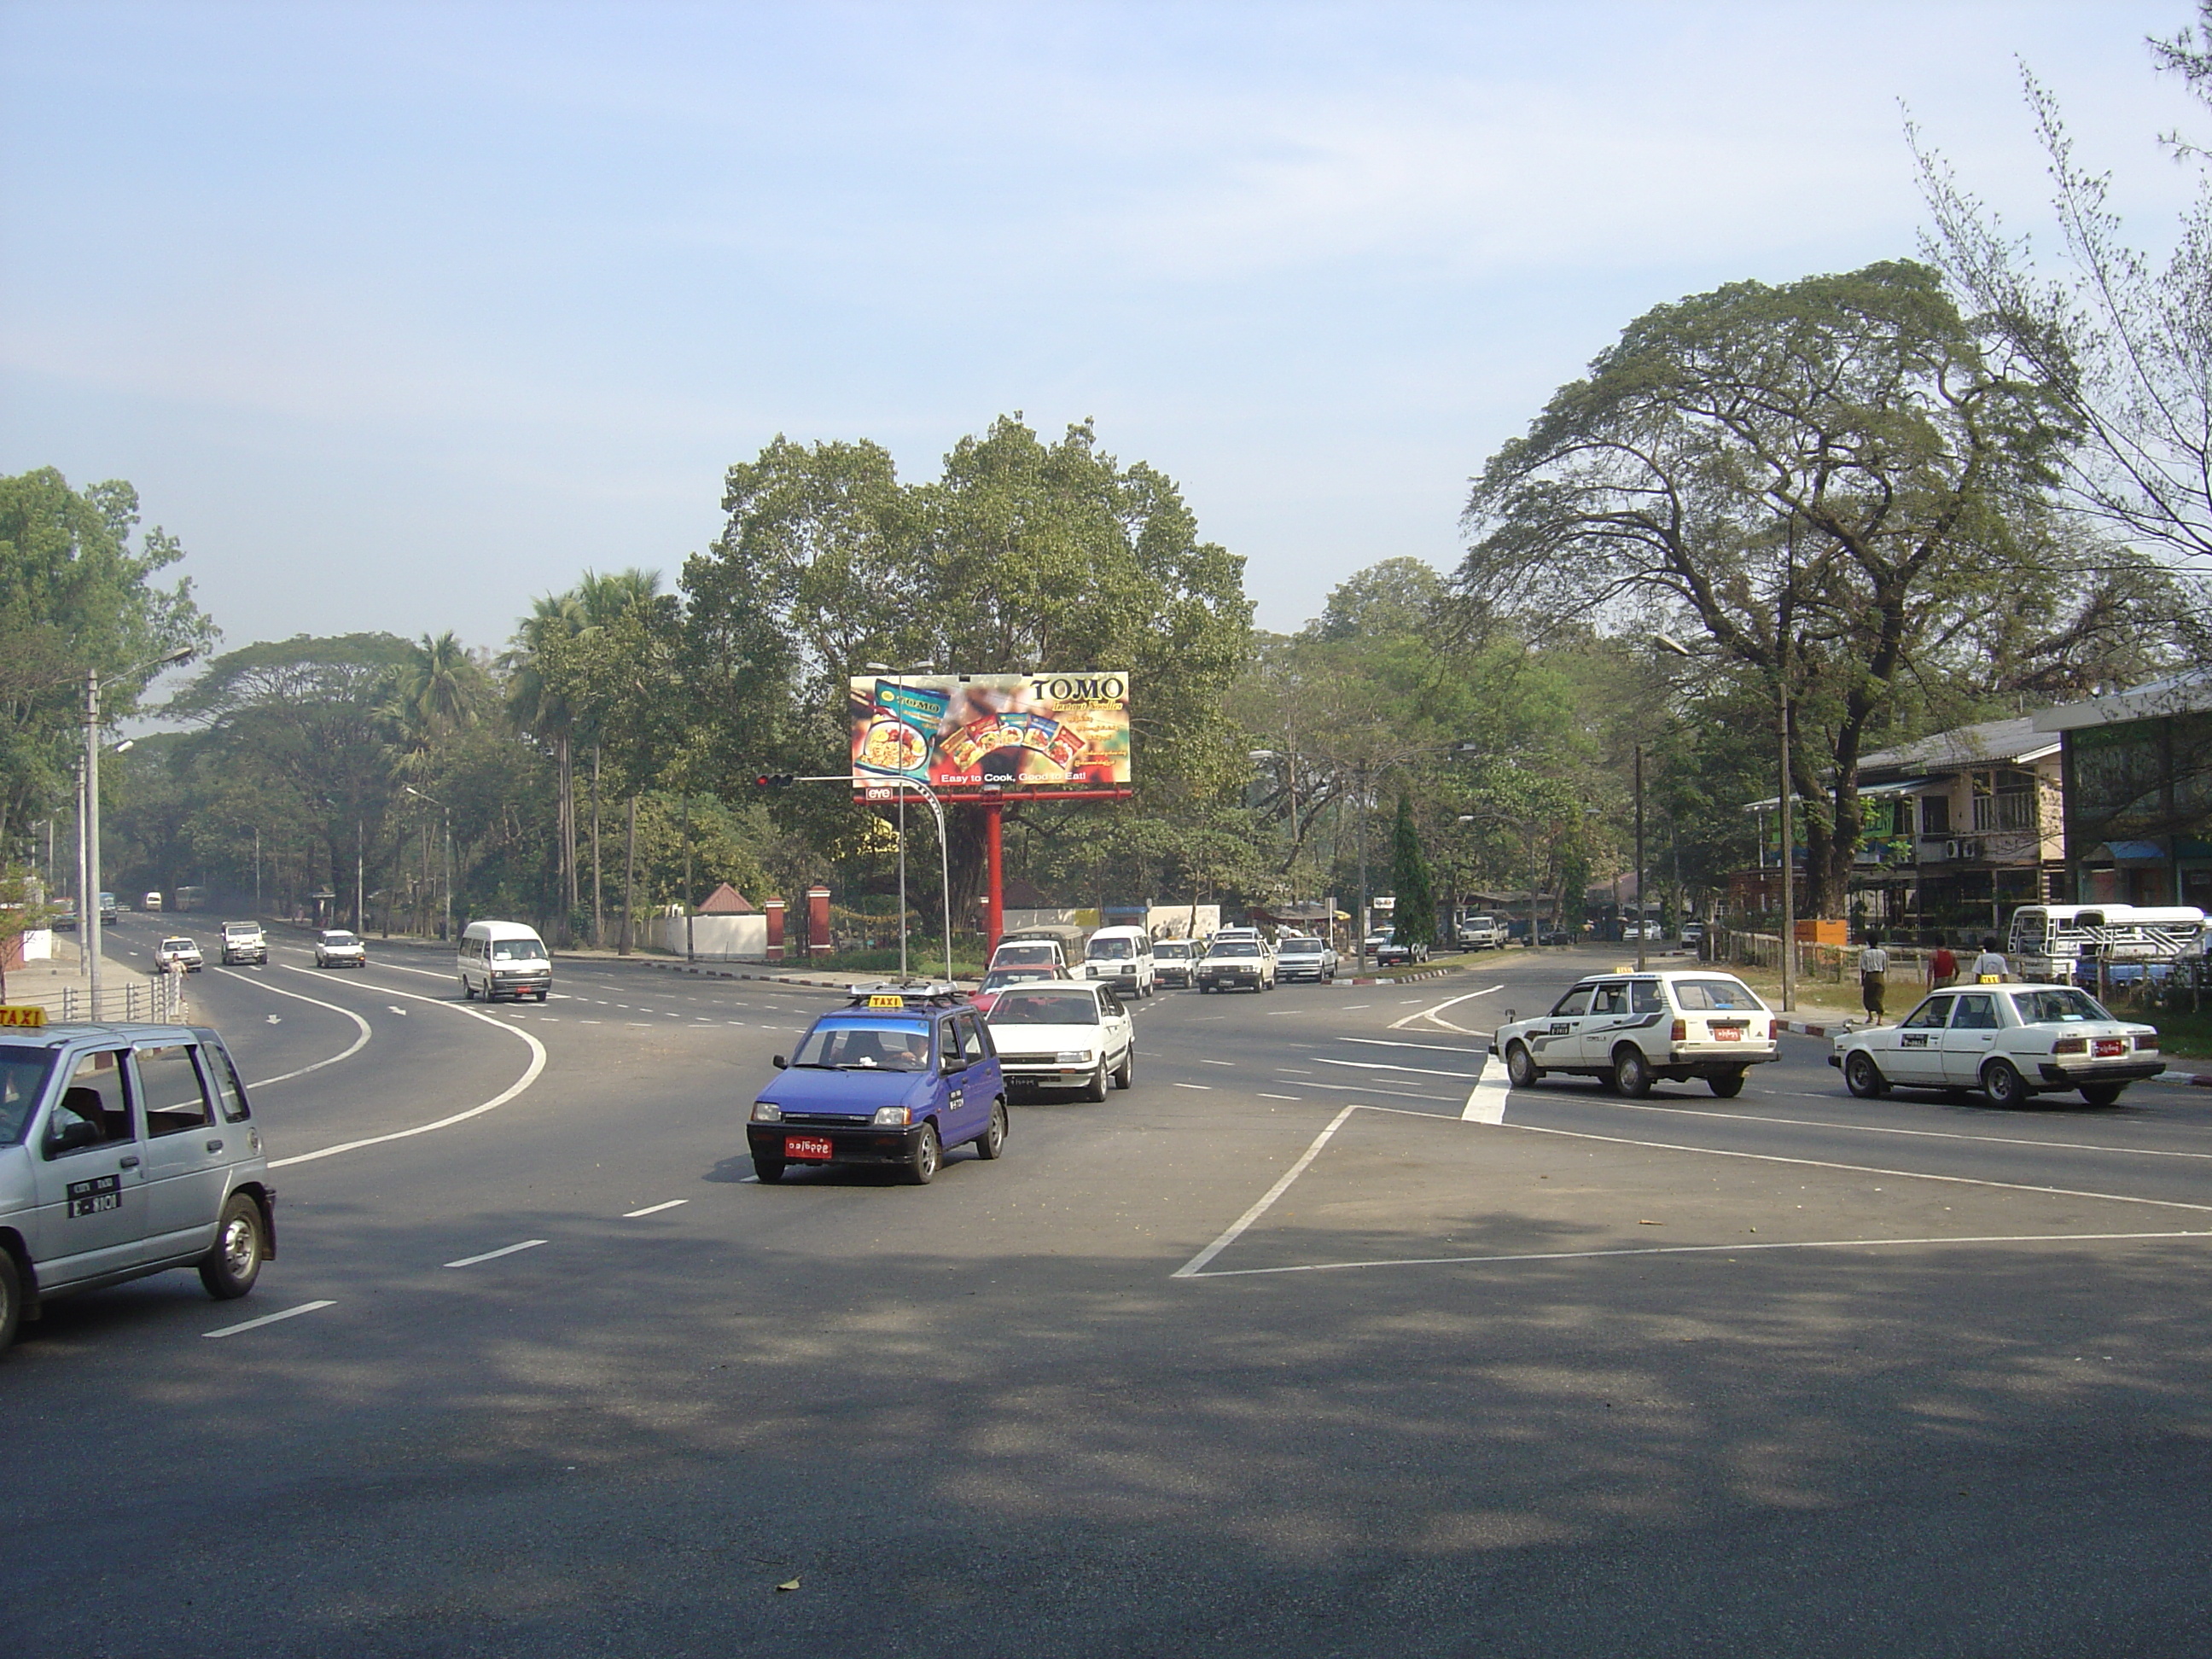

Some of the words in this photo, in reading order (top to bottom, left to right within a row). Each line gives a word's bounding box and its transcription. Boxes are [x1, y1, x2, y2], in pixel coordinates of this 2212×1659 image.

[1029, 678, 1125, 701] TOMO
[897, 696, 940, 714] TOMO
[1052, 700, 1087, 711] Instant
[1089, 699, 1123, 711] Noodles
[940, 774, 968, 784] Easy
[970, 774, 981, 783] to
[984, 772, 1016, 783] Cook,
[1018, 772, 1049, 782] Good
[1064, 771, 1086, 781] Eat!
[872, 997, 898, 1006] TAXI
[0, 1010, 40, 1025] TAXI
